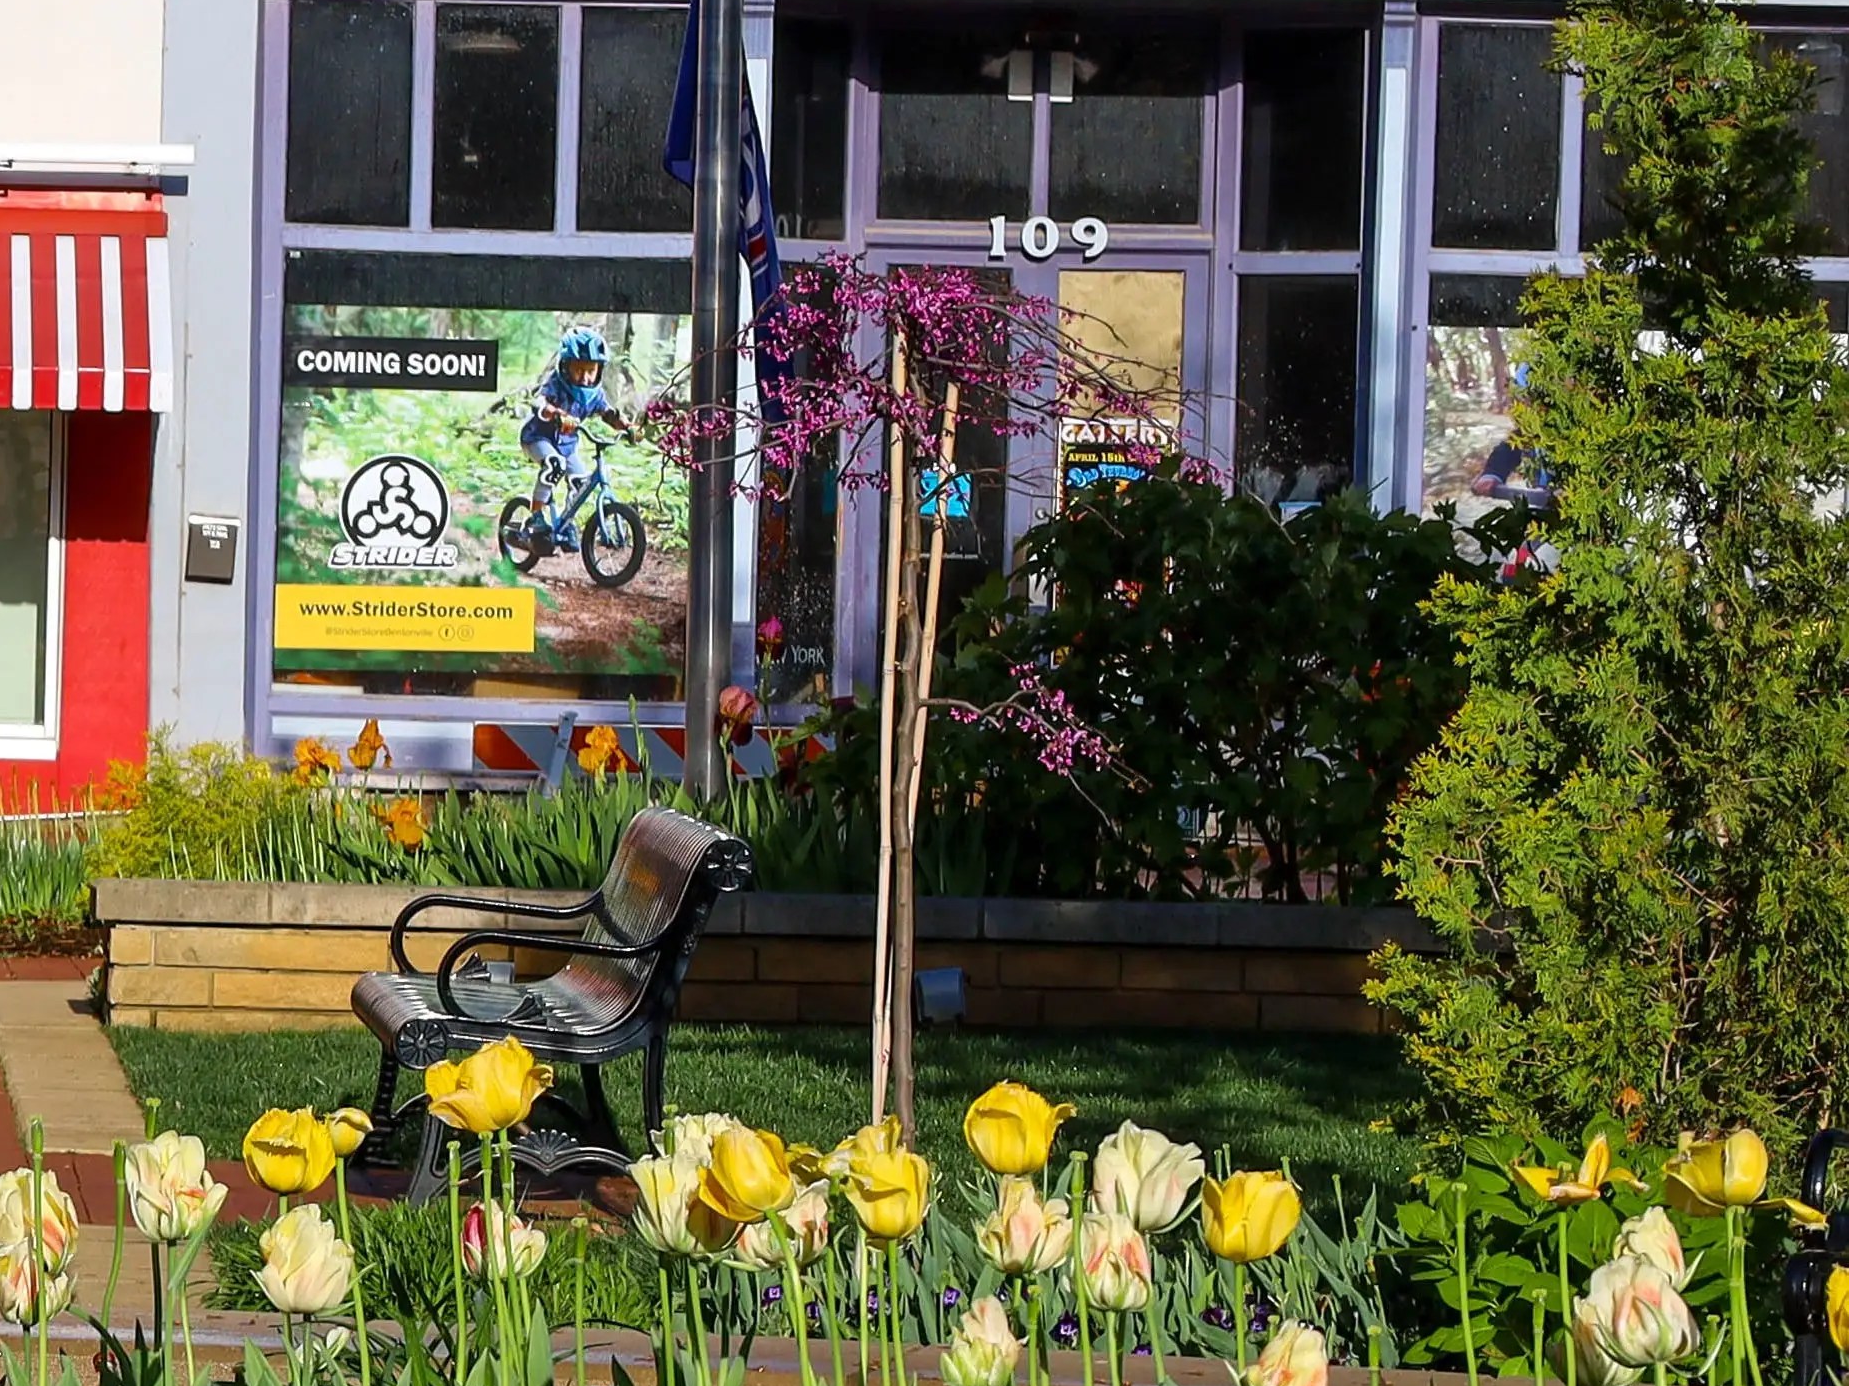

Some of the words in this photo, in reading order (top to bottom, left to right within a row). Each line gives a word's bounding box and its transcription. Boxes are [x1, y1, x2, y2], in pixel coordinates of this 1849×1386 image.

[988, 215, 1109, 262] 109
[297, 350, 401, 374] COMING
[407, 353, 486, 377] SOON!
[1068, 452, 1098, 462] APRIL
[331, 544, 456, 567] STRIDER
[299, 600, 513, 619] www.StriderStore.com
[790, 644, 826, 666] YORK
